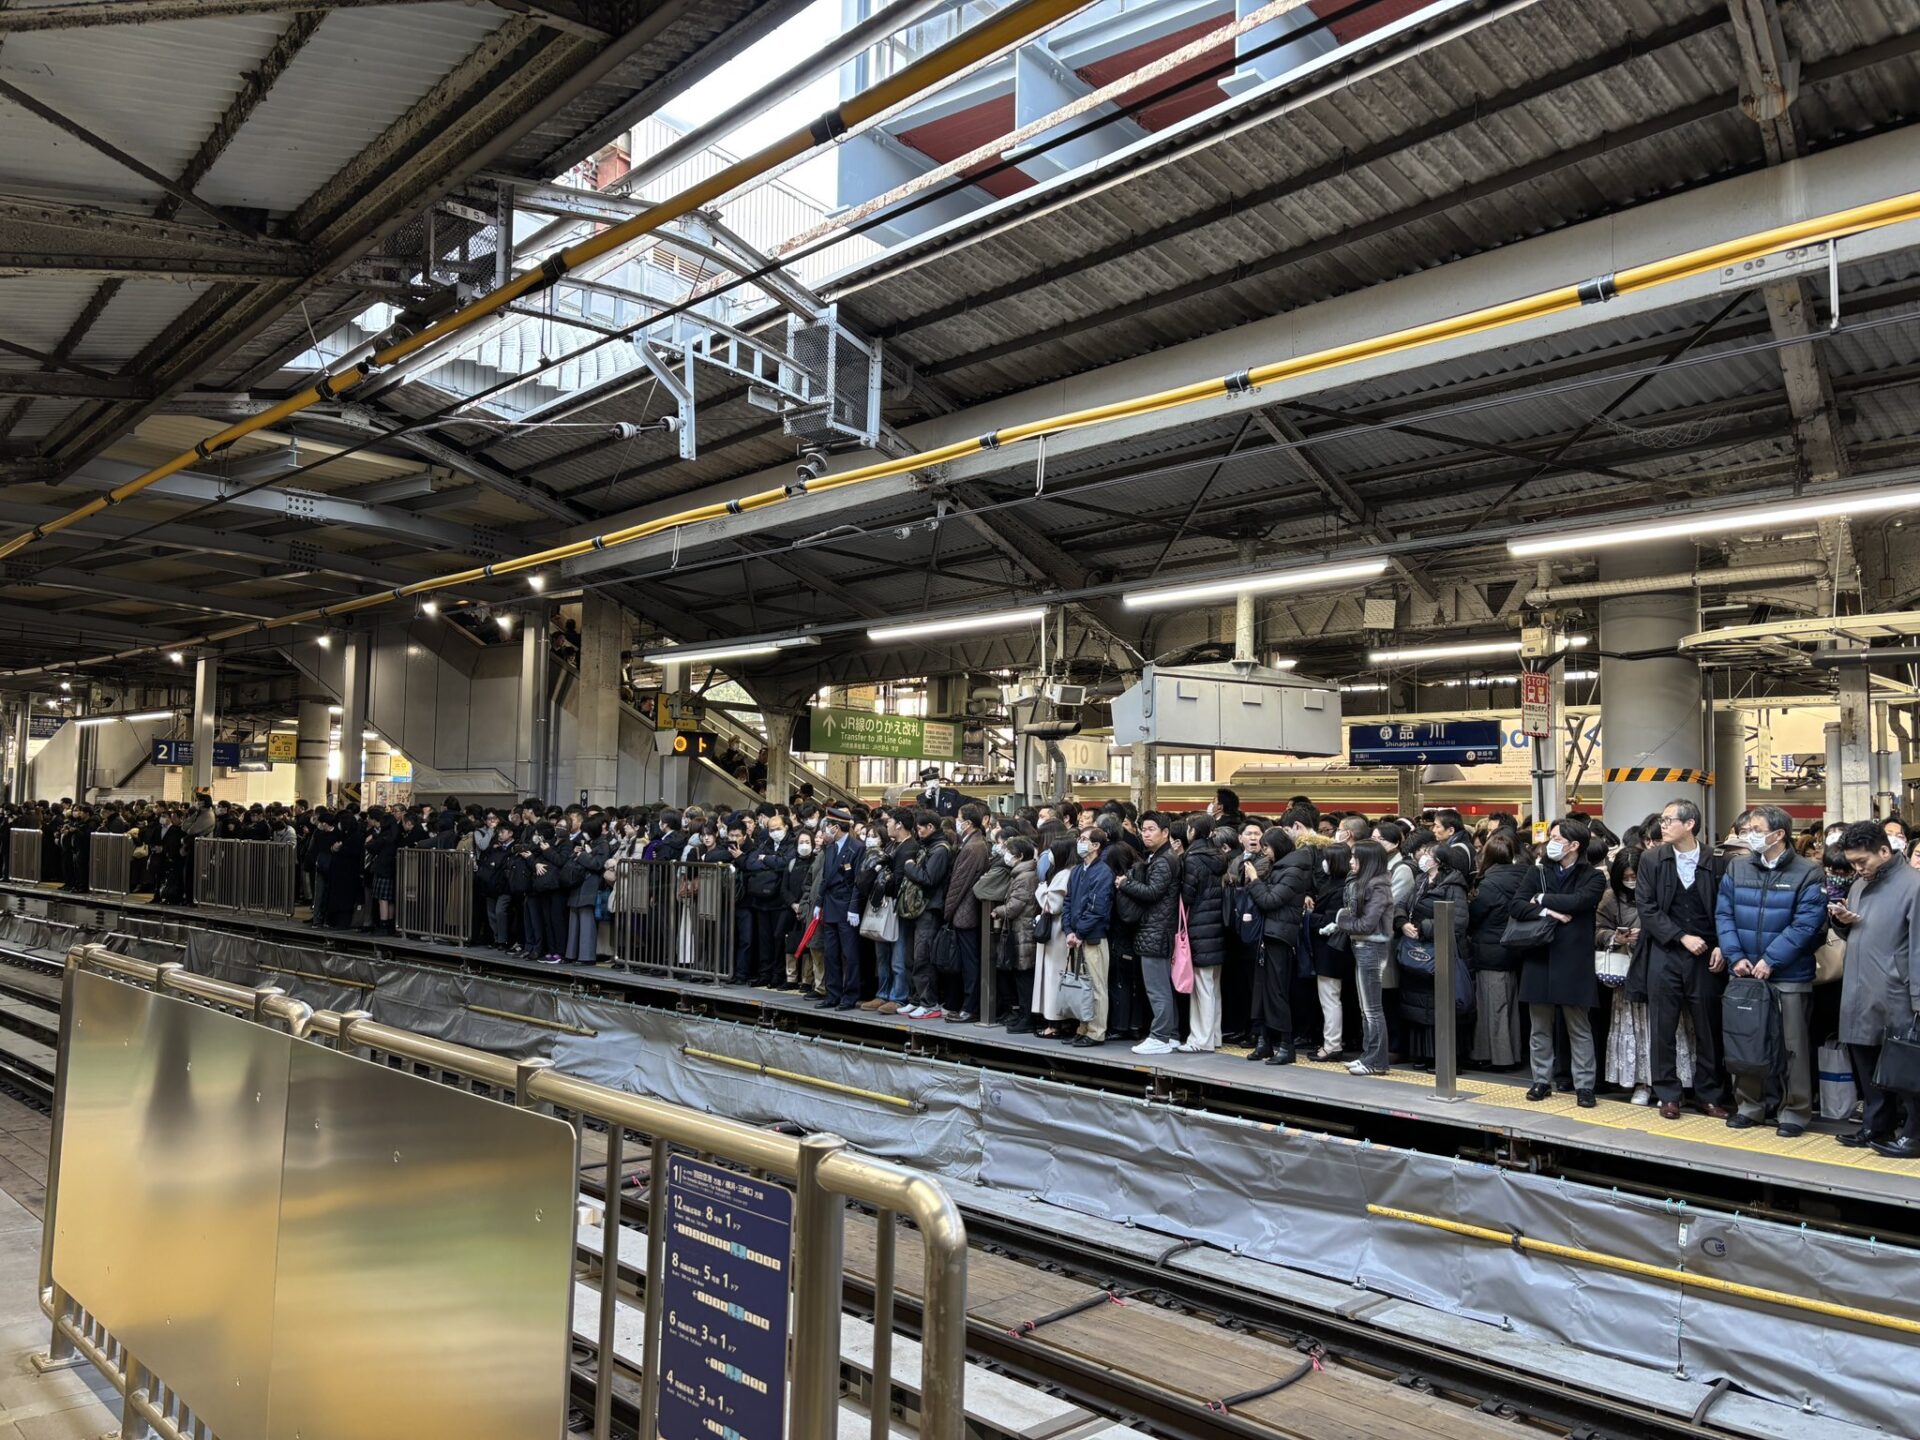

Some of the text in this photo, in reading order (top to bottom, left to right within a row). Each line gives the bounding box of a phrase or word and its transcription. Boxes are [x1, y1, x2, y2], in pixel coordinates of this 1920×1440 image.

[1527, 678, 1546, 686] STOP
[841, 717, 920, 737] JR線のりかえ改札
[1399, 723, 1445, 740] 品川
[840, 732, 912, 746] Transfer to JR Line Gate
[158, 744, 168, 760] 2
[1072, 744, 1089, 765] 10
[673, 1164, 679, 1181] 1
[673, 1194, 683, 1210] 12
[706, 1206, 713, 1221] 8
[725, 1213, 731, 1228] 1
[672, 1252, 679, 1267] 8
[703, 1265, 711, 1280] 5
[722, 1273, 728, 1288] 1
[669, 1310, 676, 1325] 6
[701, 1324, 708, 1340] 3
[720, 1333, 726, 1349] 1
[666, 1369, 674, 1385] 4
[699, 1385, 706, 1401] 3
[718, 1395, 724, 1411] 1
